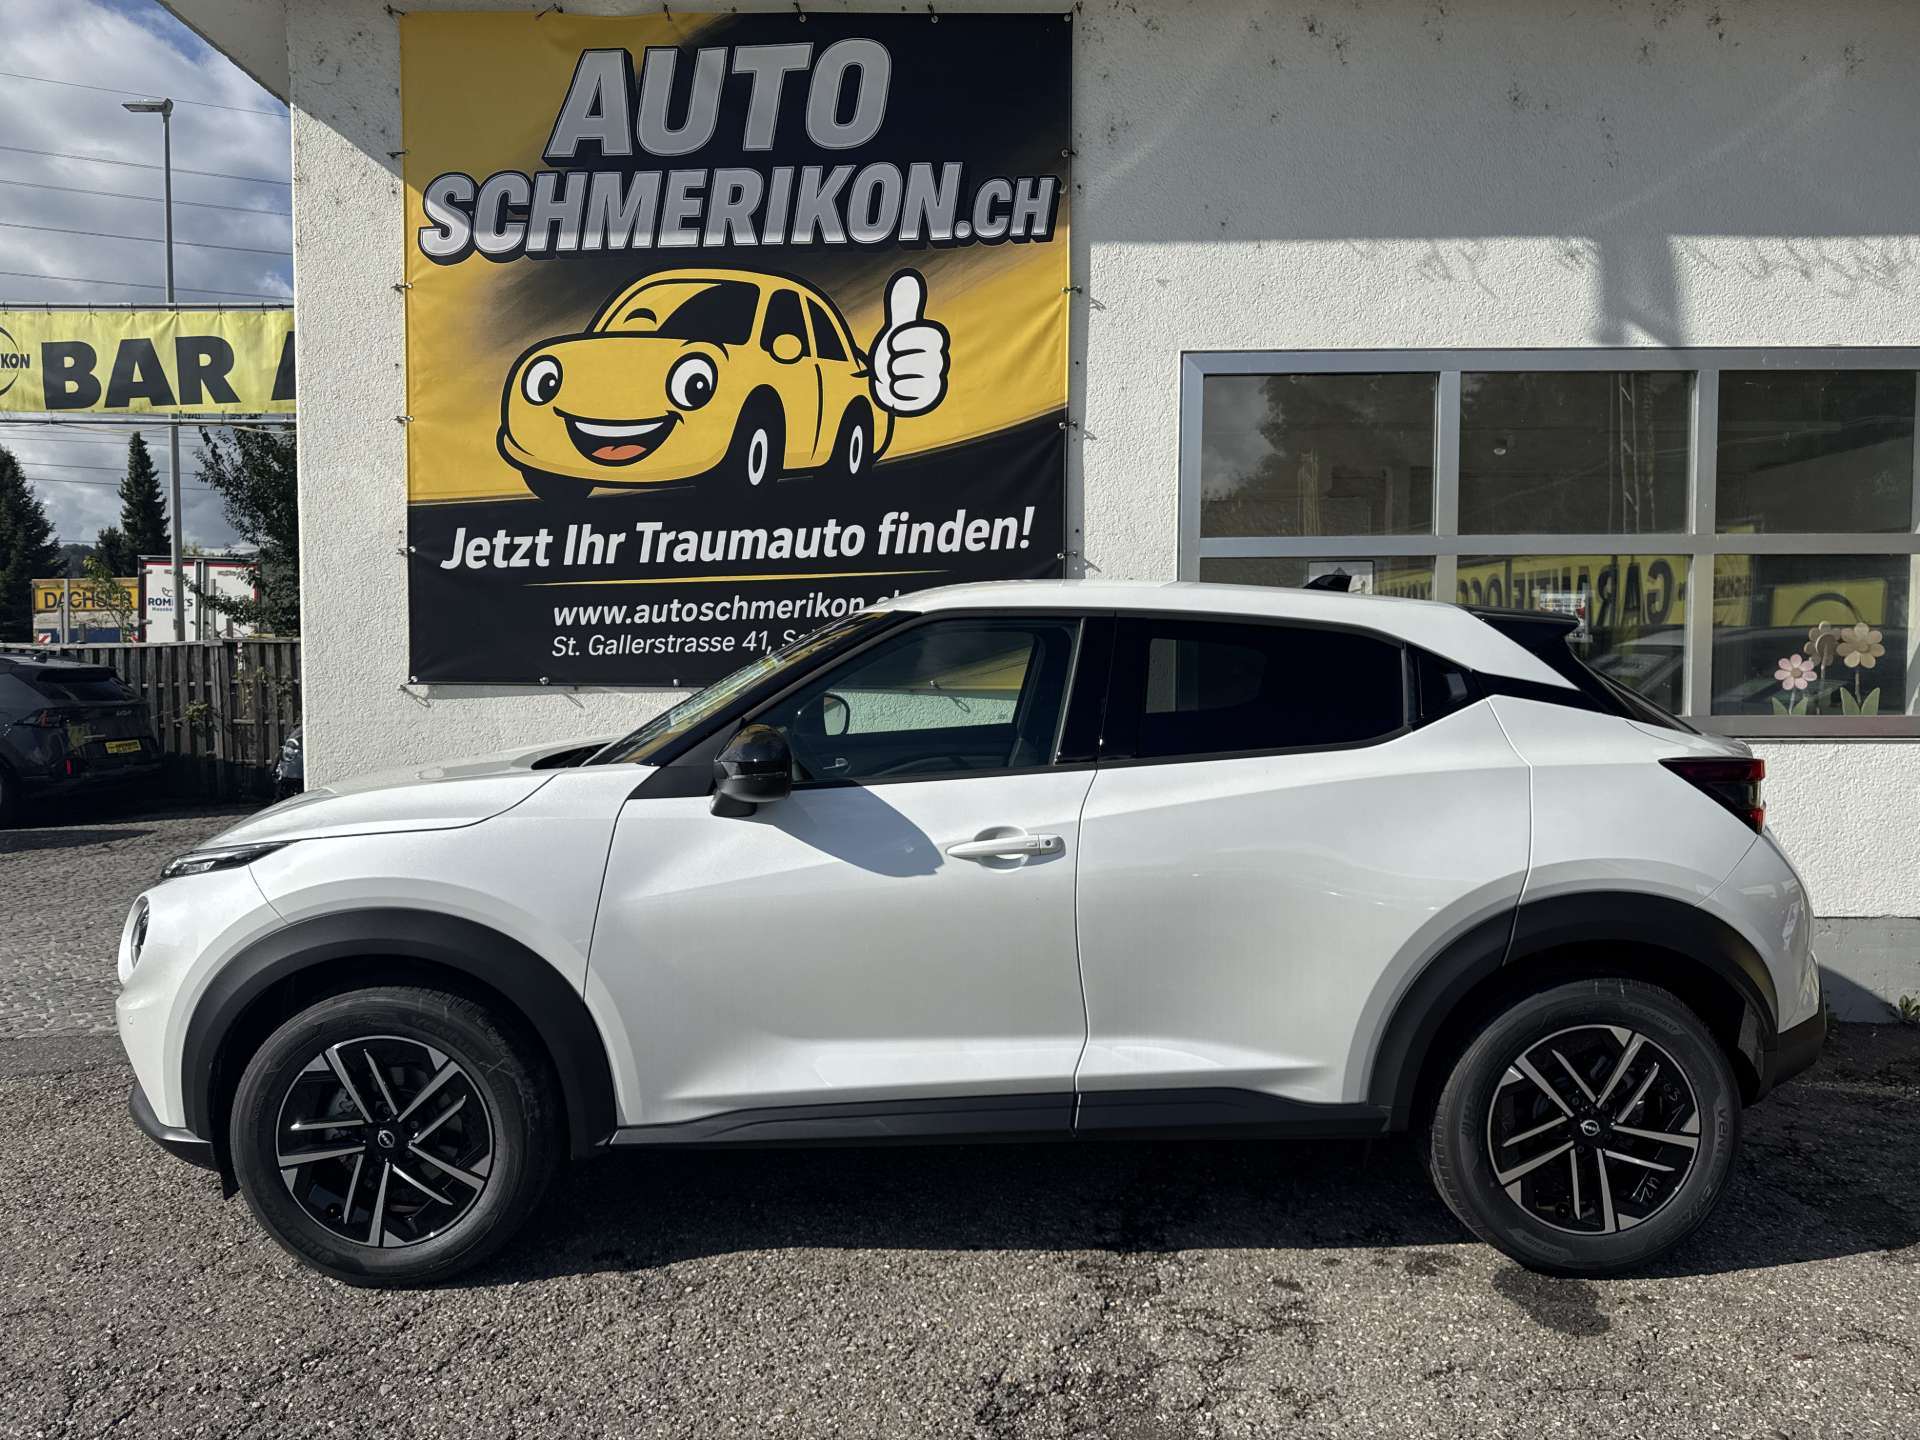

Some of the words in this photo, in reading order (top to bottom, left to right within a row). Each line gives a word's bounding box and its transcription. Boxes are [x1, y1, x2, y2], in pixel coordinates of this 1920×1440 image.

[542, 37, 892, 166] AUTO
[419, 160, 1058, 262] SCHMERIKON.CH
[41, 335, 242, 410] BAR
[440, 525, 553, 570] Jetzt
[564, 522, 627, 565] Ihr
[635, 517, 866, 564] Traumauto
[877, 506, 1036, 556] finden!
[551, 635, 580, 657] St.
[588, 634, 736, 656] Gallerstrasse
[742, 630, 772, 655] 41,
